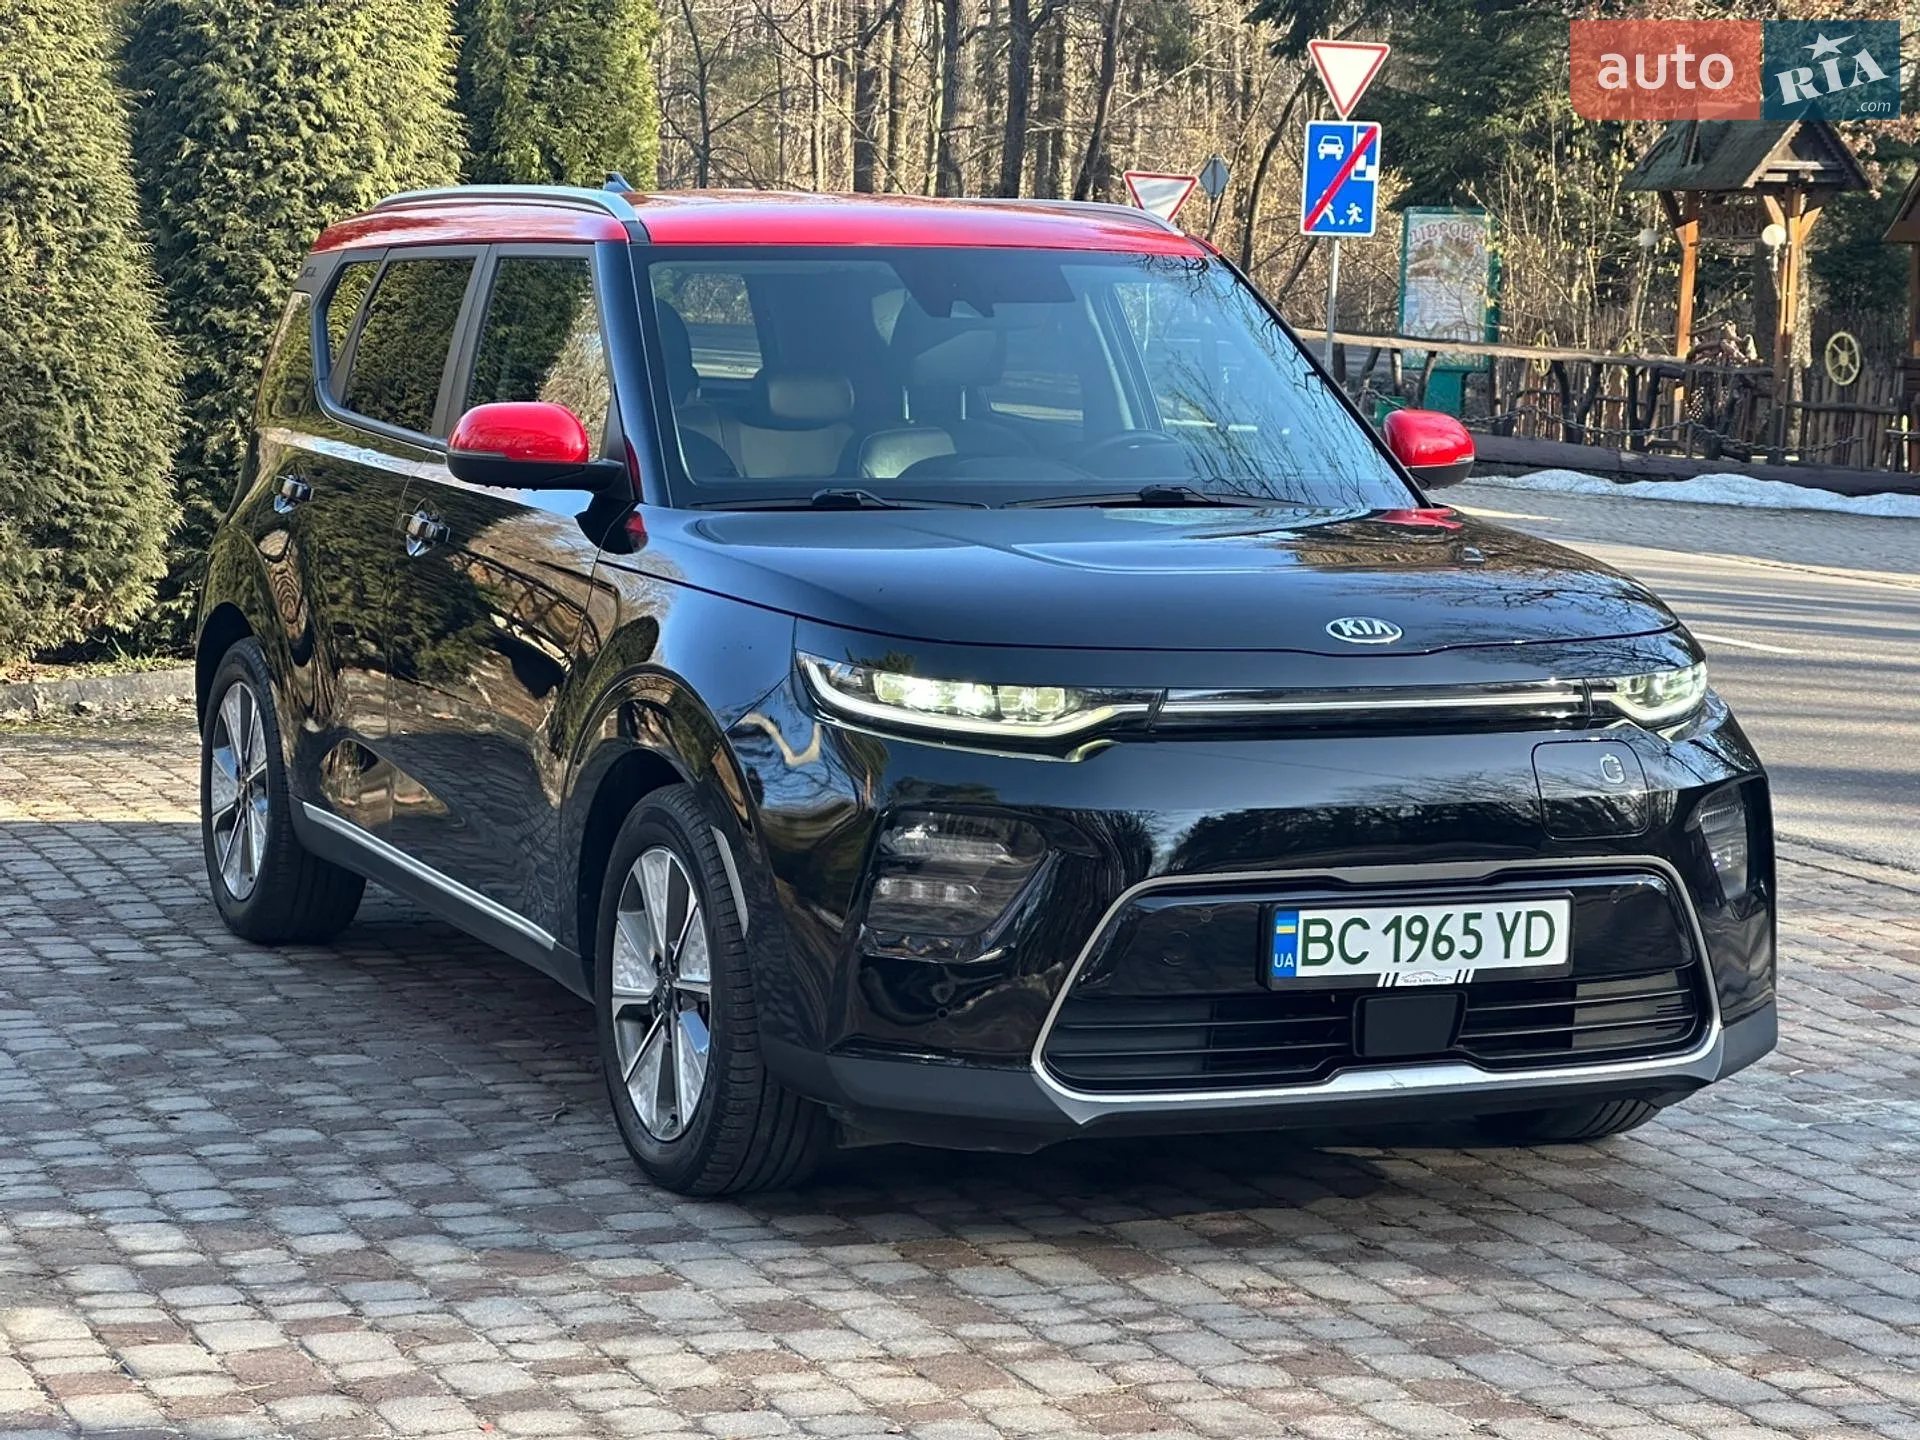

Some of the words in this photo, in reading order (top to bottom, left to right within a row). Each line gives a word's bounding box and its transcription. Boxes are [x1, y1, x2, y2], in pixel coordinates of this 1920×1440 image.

[1337, 619, 1394, 636] KIA
[1301, 917, 1371, 966] BC
[1382, 912, 1483, 963] 1965
[1496, 909, 1556, 959] YD
[1274, 952, 1295, 968] UA
